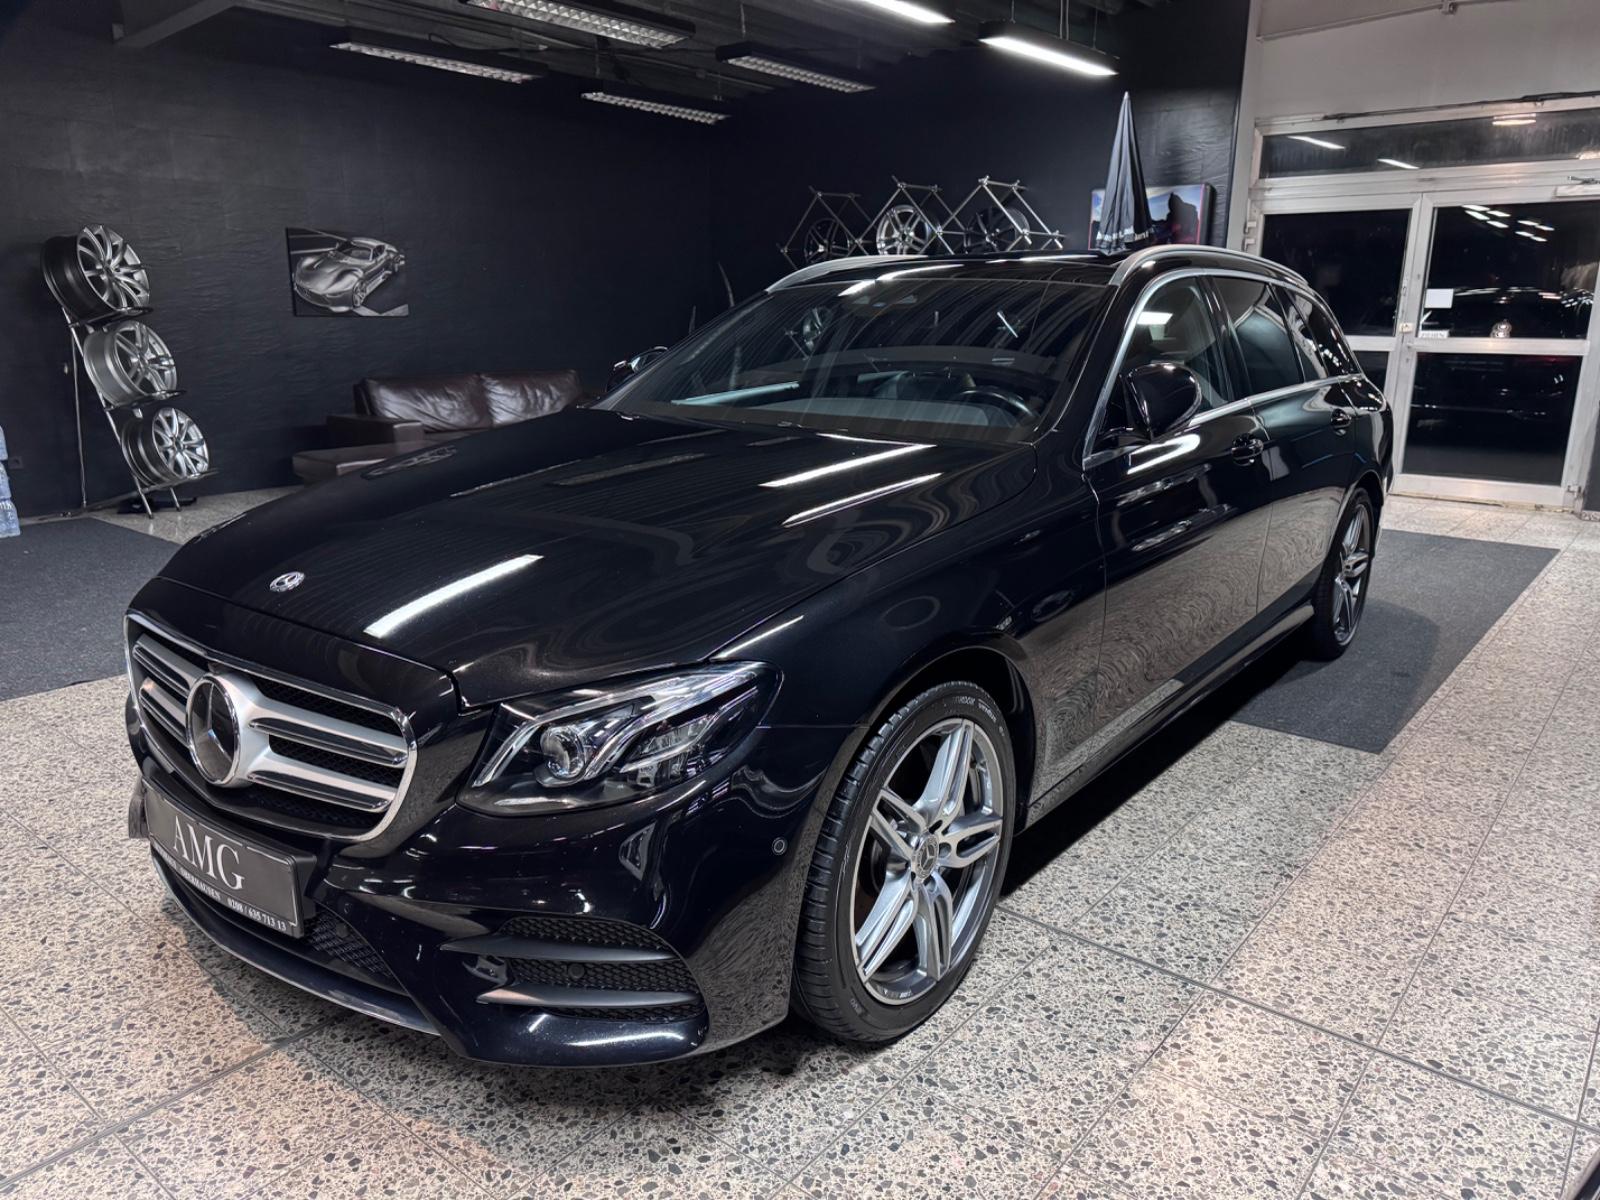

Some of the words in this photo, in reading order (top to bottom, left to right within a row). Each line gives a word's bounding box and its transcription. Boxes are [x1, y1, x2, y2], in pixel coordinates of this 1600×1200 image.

[172, 815, 245, 890] AMG
[262, 913, 276, 927] 713
[277, 919, 287, 931] 13
